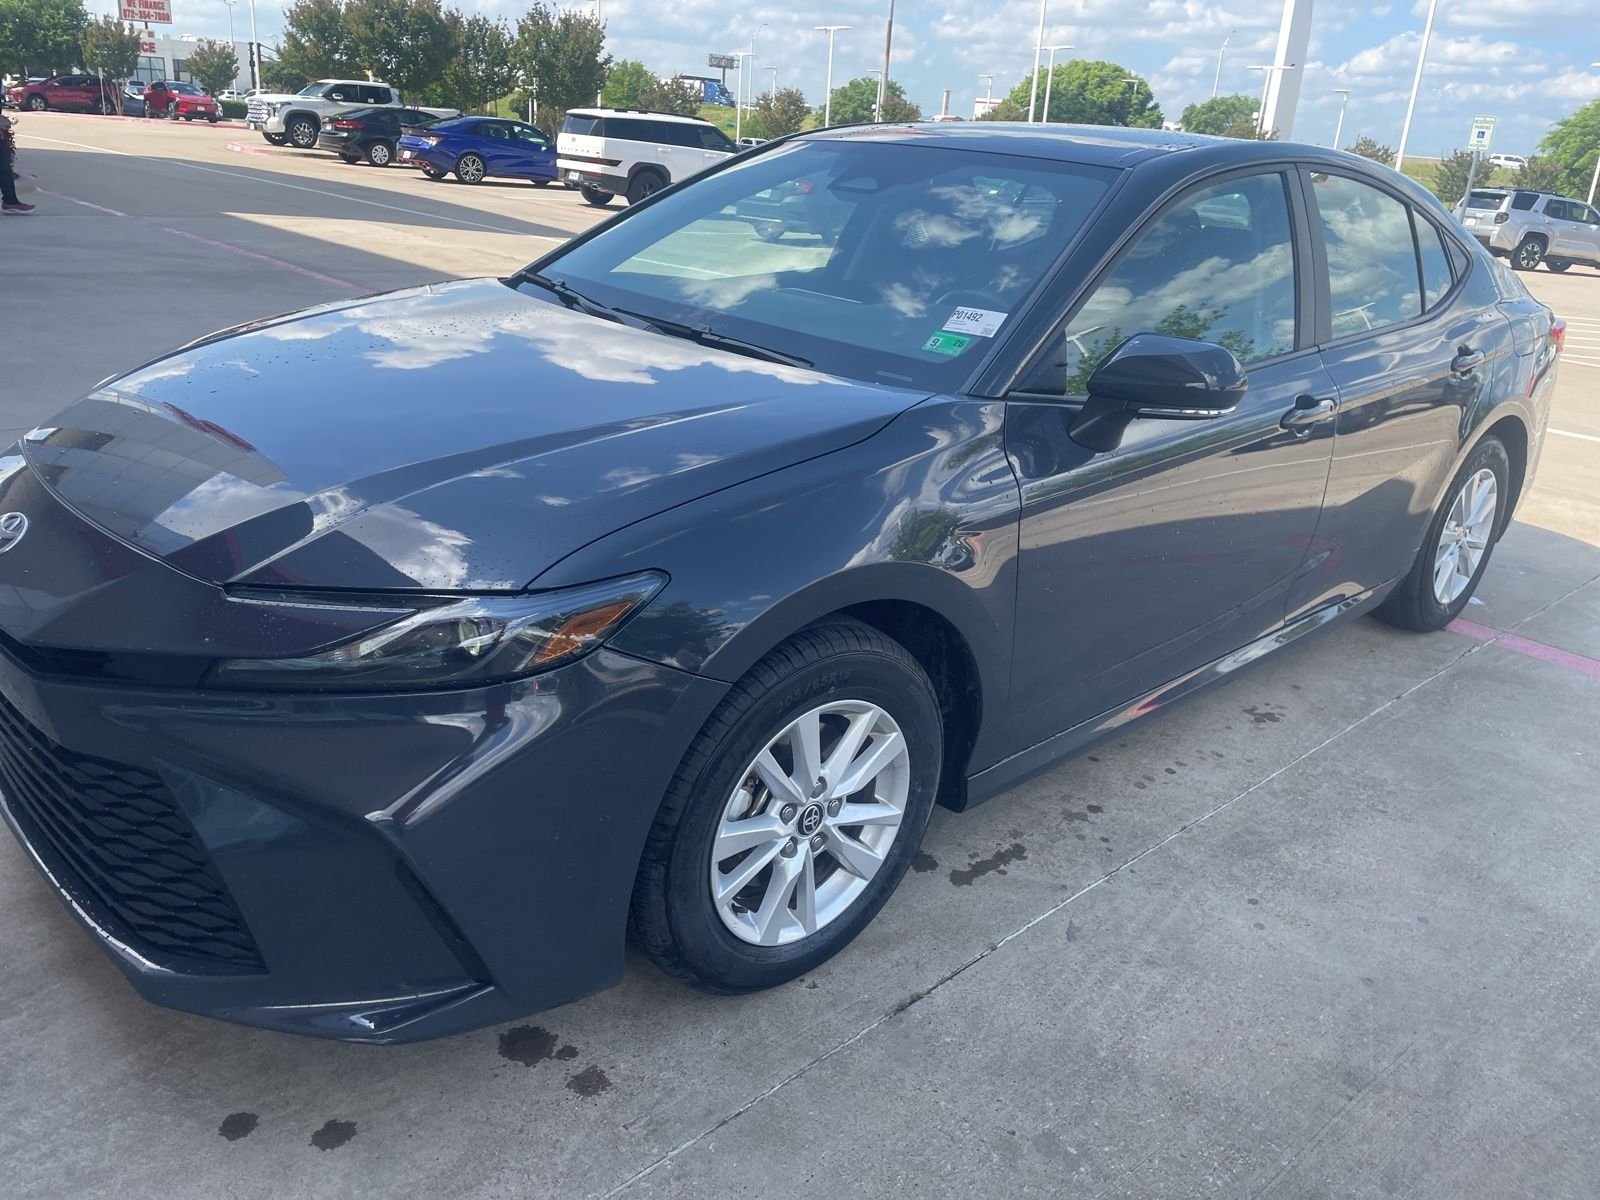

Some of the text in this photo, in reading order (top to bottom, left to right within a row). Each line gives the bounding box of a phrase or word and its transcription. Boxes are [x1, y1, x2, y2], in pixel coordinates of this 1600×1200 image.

[126, 0, 166, 11] WE FINANCE
[951, 310, 984, 322] P01492
[930, 338, 940, 347] 9
